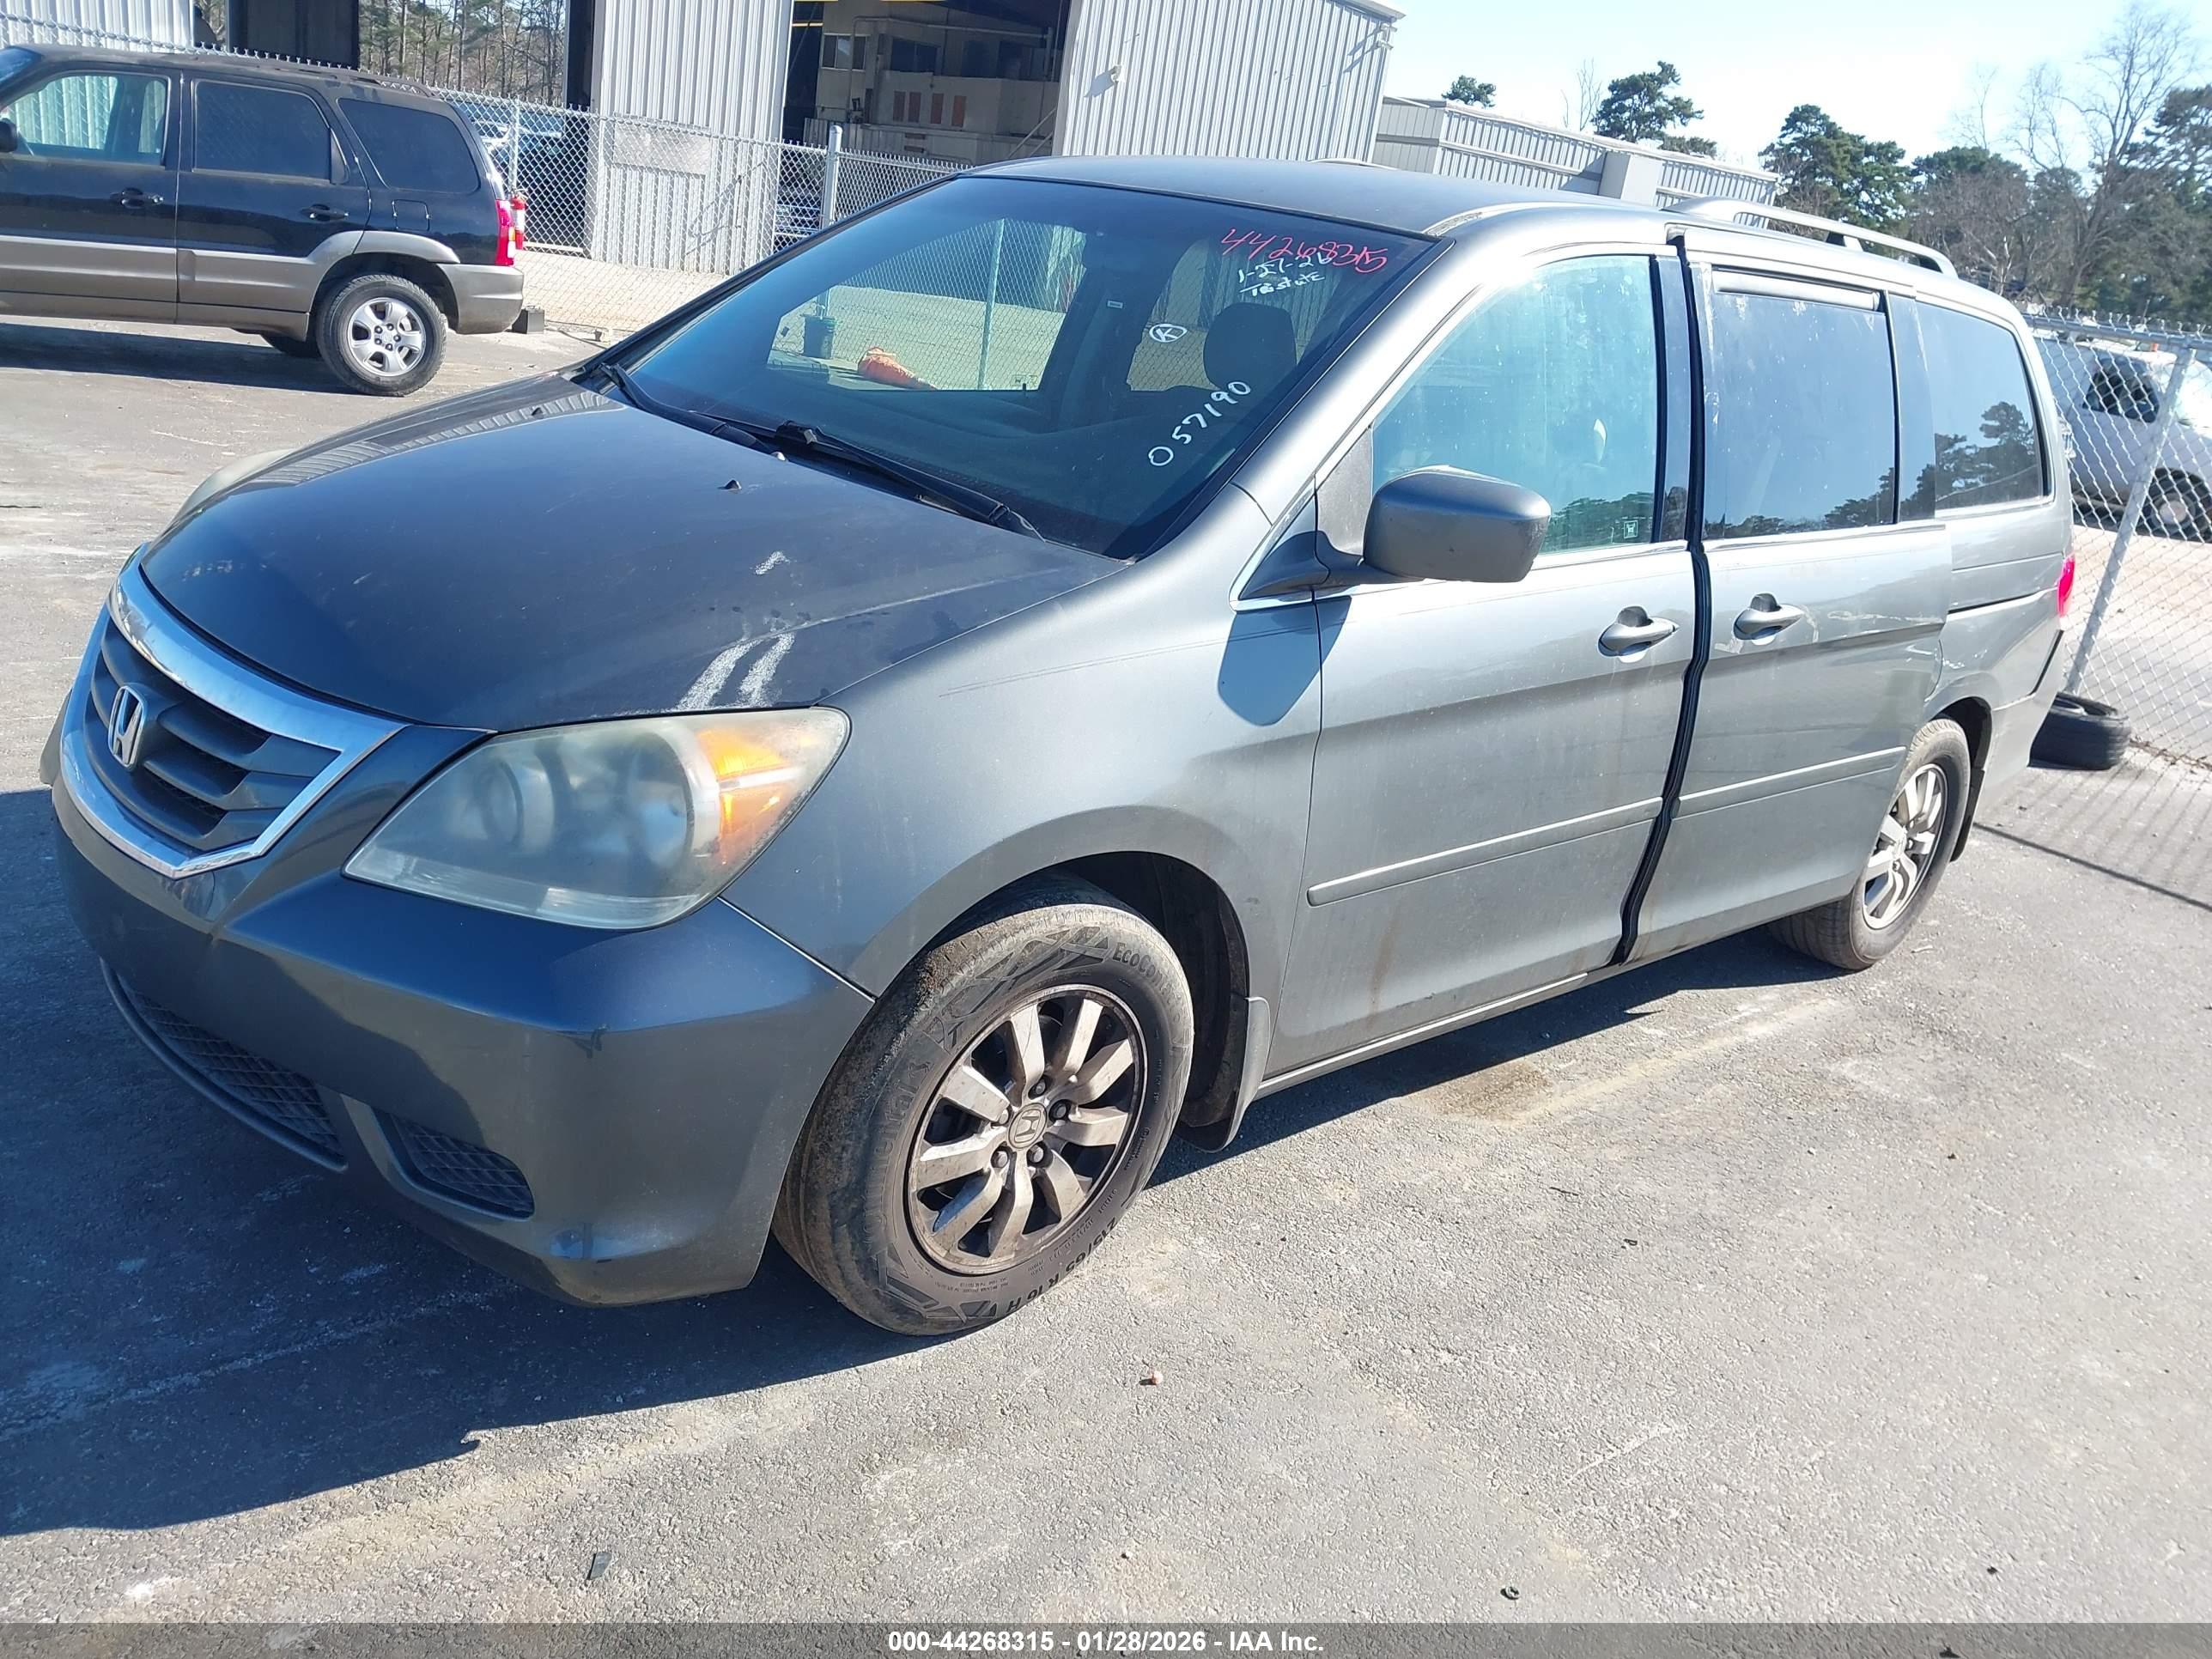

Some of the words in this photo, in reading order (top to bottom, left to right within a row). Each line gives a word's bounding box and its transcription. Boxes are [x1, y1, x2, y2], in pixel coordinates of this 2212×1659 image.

[1221, 228, 1389, 273] 44268315
[1066, 1217, 1116, 1273] 215/65
[1027, 1285, 1043, 1300] 16
